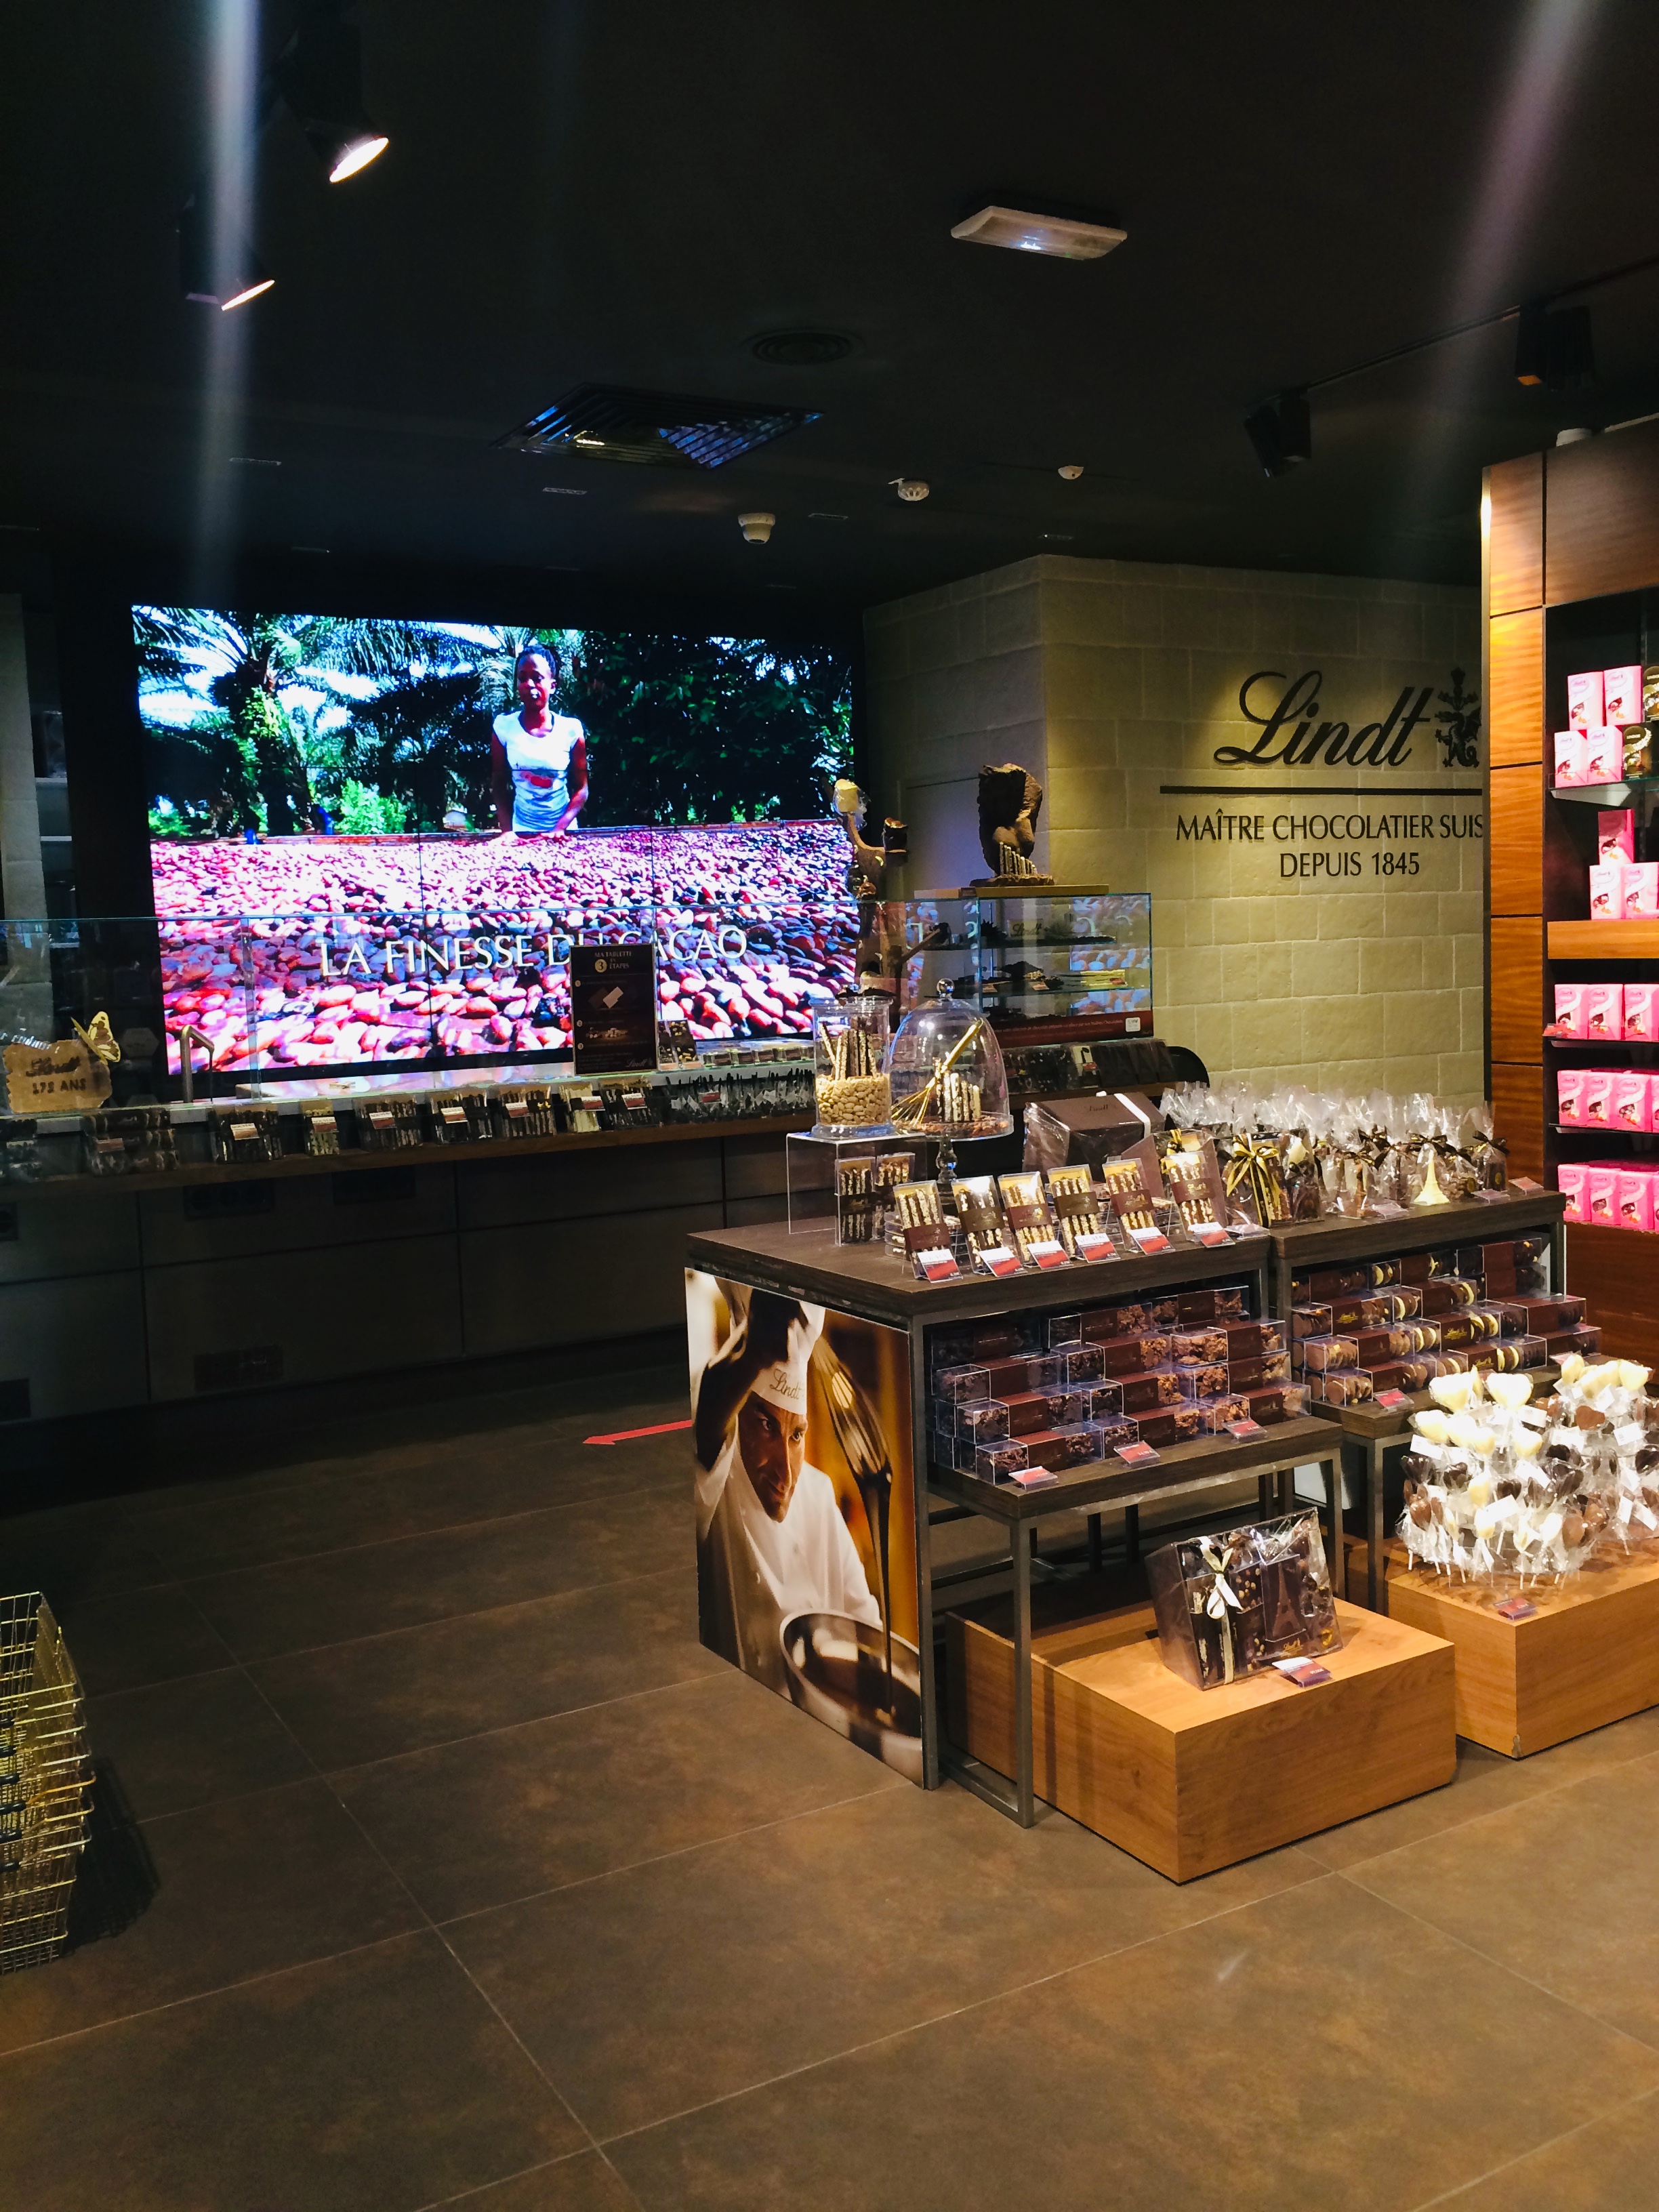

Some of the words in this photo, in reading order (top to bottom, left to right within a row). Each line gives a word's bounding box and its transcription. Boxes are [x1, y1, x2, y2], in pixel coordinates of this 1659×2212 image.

[1214, 670, 1434, 766] Lindt
[1176, 808, 1265, 841] MAÎTRE
[1273, 815, 1434, 840] CHOCOLATIER
[1280, 852, 1361, 878] DEPUIS
[1372, 852, 1420, 876] 1845
[321, 942, 371, 977] LA
[386, 935, 534, 974] FINESSE
[769, 1368, 802, 1400] Lindt
